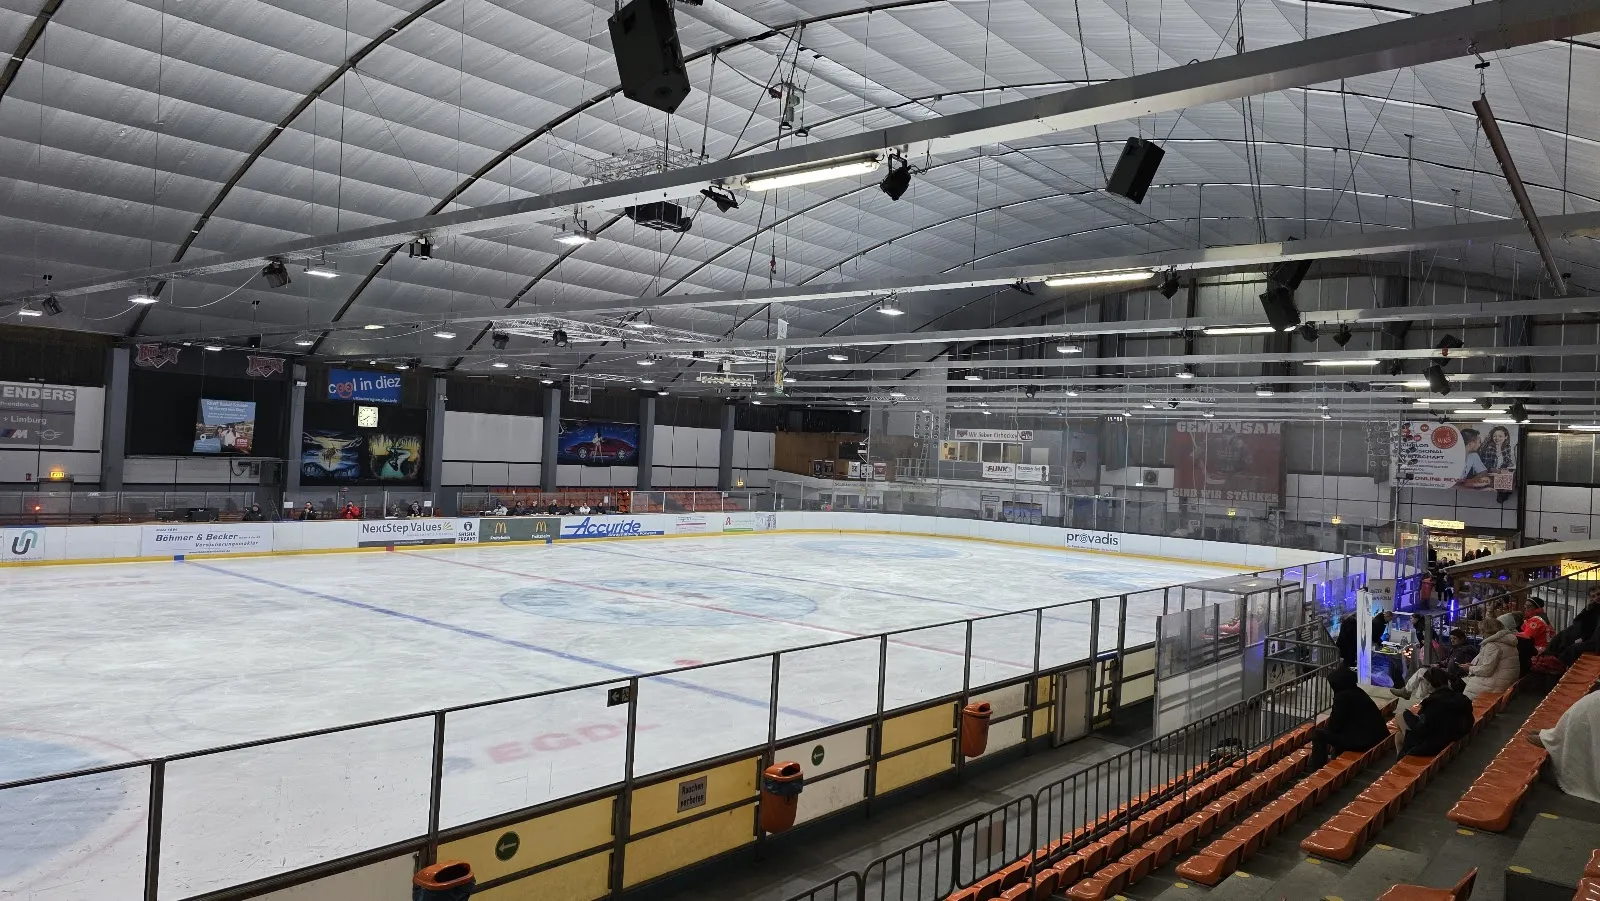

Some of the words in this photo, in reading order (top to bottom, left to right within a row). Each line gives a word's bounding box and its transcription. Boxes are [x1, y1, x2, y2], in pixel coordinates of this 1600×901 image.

[360, 378, 373, 391] in
[375, 376, 402, 389] diez
[3, 386, 75, 402] ENDERS
[11, 416, 47, 425] Limburg
[1176, 421, 1281, 434] GEMEINSAM
[1172, 487, 1198, 497] SIND
[1200, 489, 1222, 499] WIR
[1226, 489, 1279, 503] STÄRKER
[362, 523, 409, 534] NextStep
[410, 521, 442, 532] Values
[565, 517, 641, 535] Accuride
[155, 534, 194, 542] Böhmer
[196, 533, 203, 541] &
[206, 532, 239, 541] Becker
[681, 783, 704, 796] Rauchen
[680, 794, 704, 807] verboten
